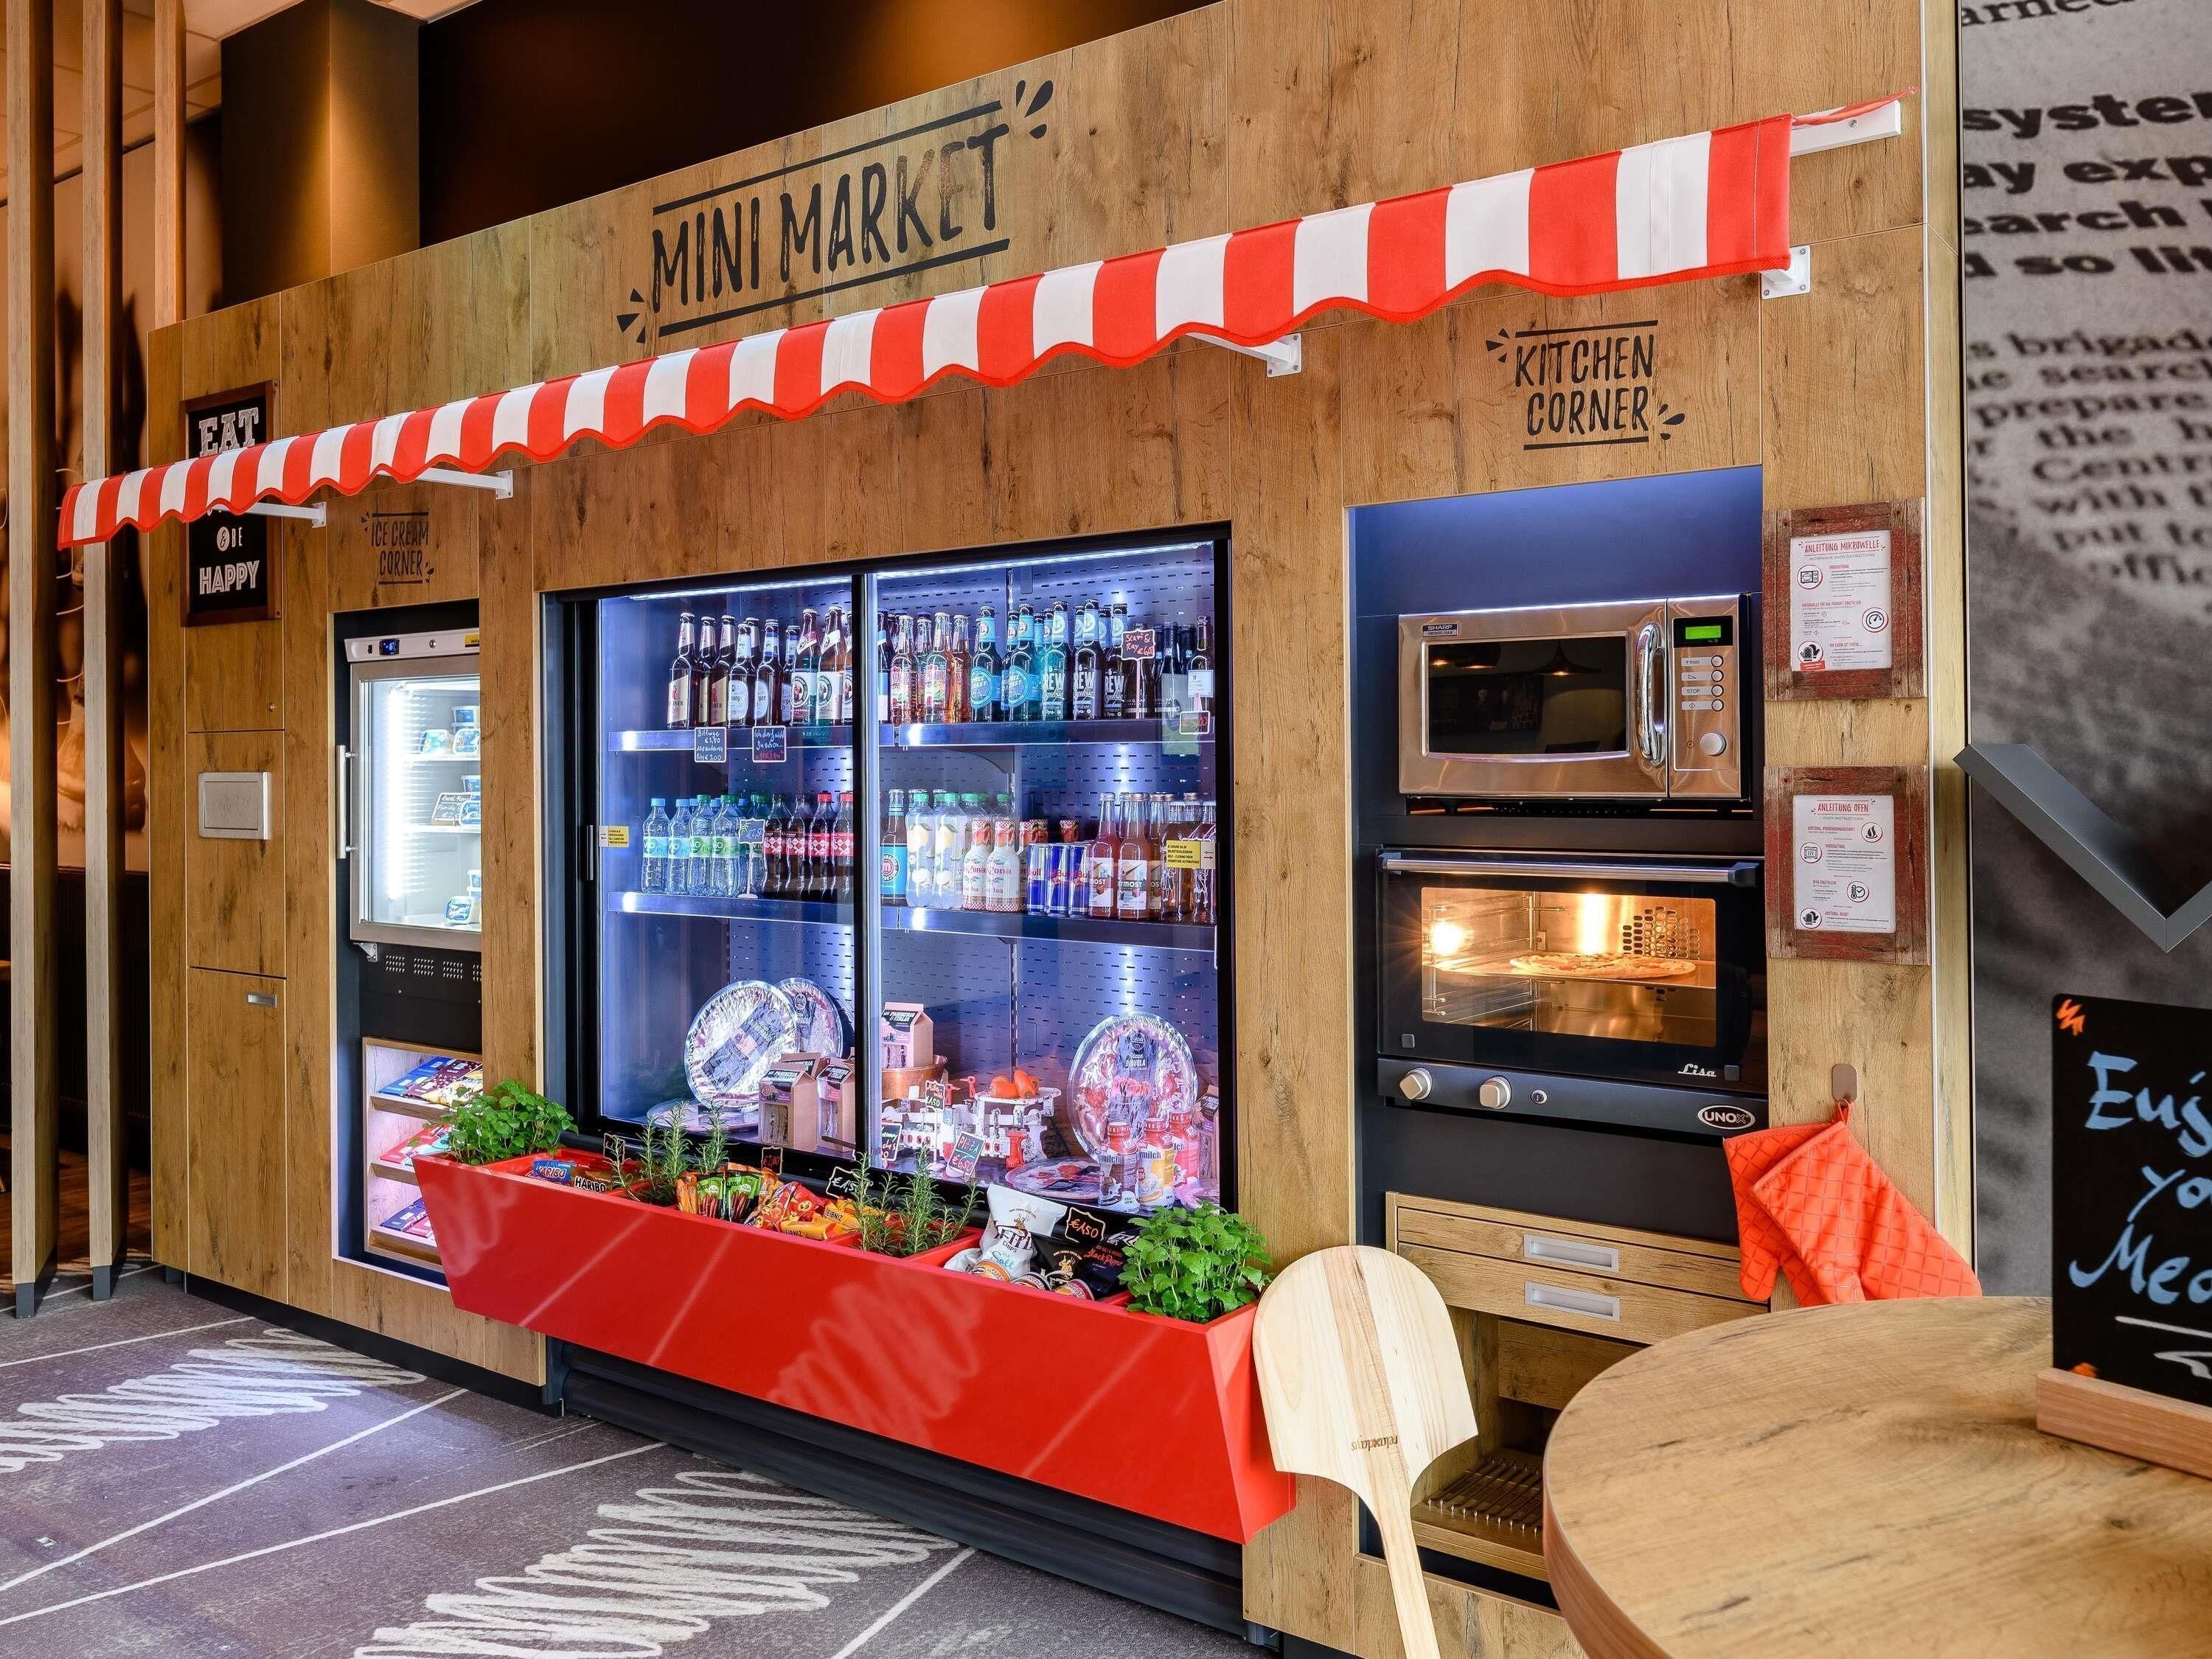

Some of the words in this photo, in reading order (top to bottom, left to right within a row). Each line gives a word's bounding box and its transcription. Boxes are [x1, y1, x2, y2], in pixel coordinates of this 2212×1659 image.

[653, 197, 760, 313] MINI
[780, 123, 1009, 282] MARKET
[1515, 334, 1654, 386] KITCHEN
[1528, 386, 1649, 436] CORNER
[198, 406, 260, 458] EAT
[2032, 454, 2212, 483] Centr
[232, 526, 243, 547] BE
[371, 523, 389, 548] ICE
[391, 520, 430, 548] CREAM
[1804, 543, 1839, 554] ANLEITUNG
[1840, 539, 1880, 551] MIKROWELLE
[378, 550, 423, 577] CORNER
[198, 560, 260, 595] HAPPY
[1818, 802, 1852, 813] ANLEITUNG
[1854, 803, 1868, 813] OFEN
[1677, 1063, 1717, 1077] Lisa
[1704, 1111, 1747, 1124] UNOX
[535, 1165, 567, 1179] HARIBO
[574, 1176, 607, 1193] HARIBO
[1002, 1240, 1018, 1253] CHIPS
